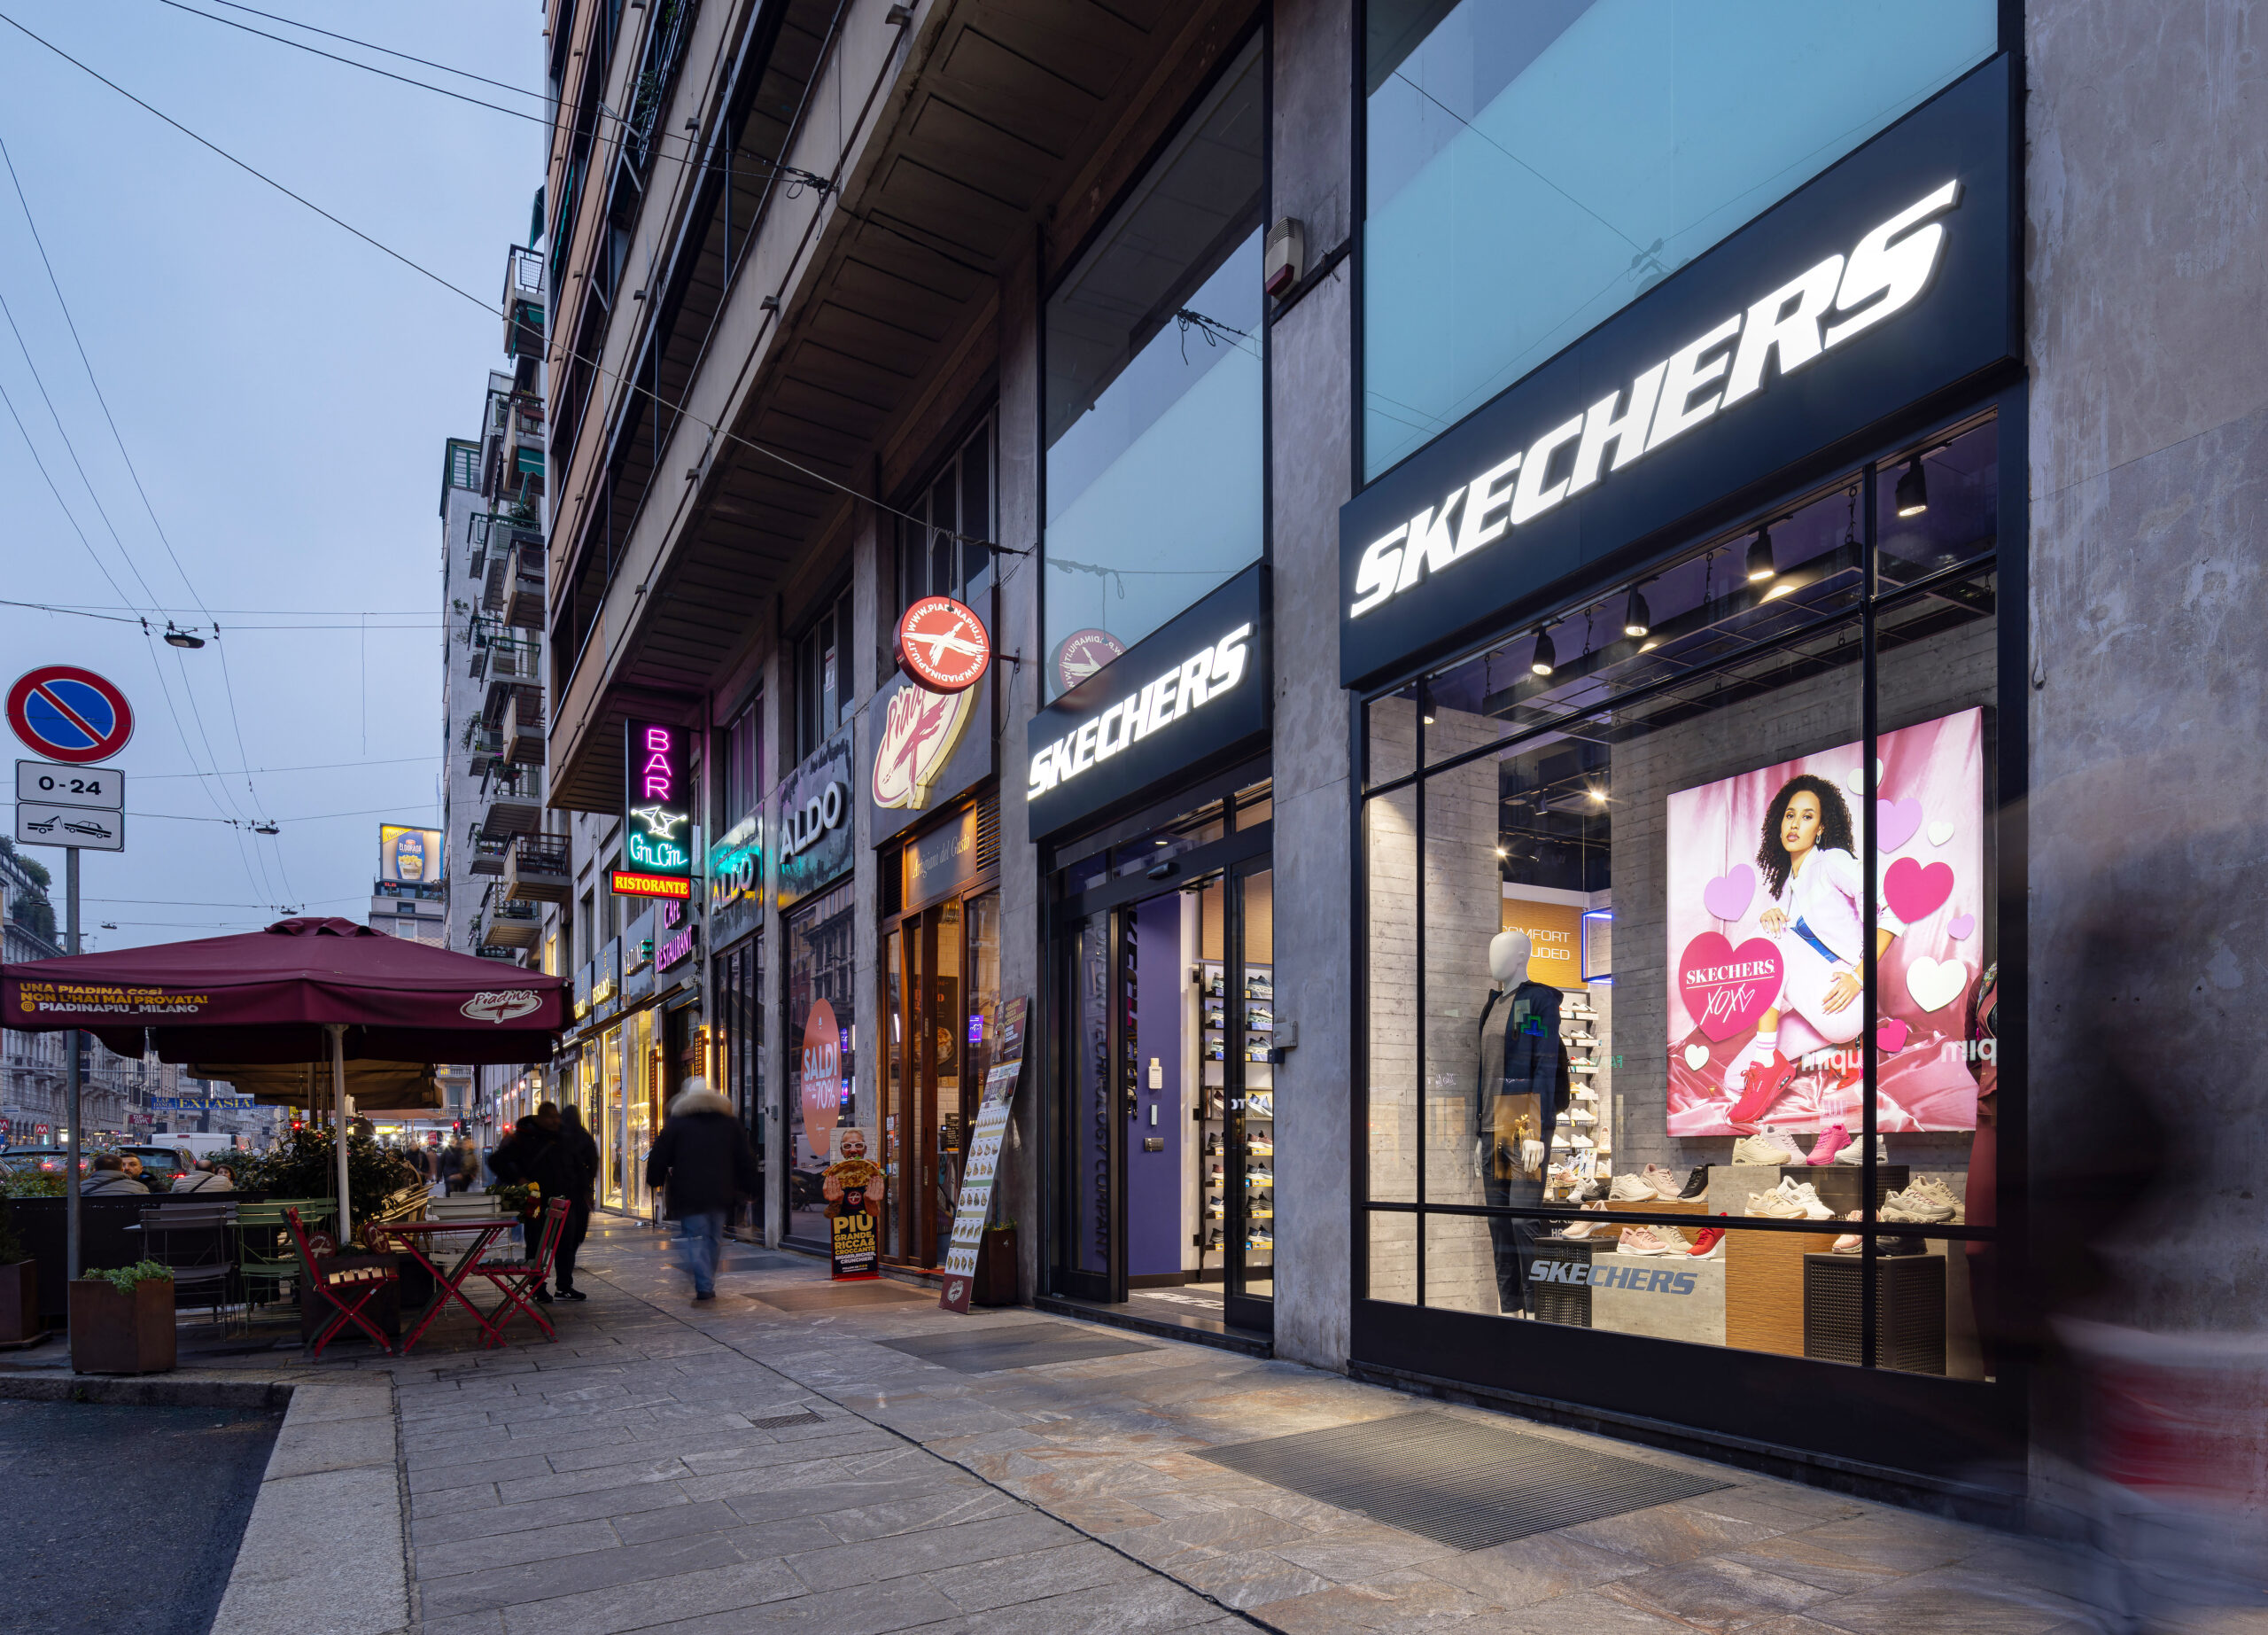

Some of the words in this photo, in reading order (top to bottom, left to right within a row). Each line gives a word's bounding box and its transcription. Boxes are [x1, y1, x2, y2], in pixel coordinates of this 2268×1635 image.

[1350, 179, 1961, 619] SKECHERS
[907, 603, 983, 645] WWW.PIADNAPIU.IT
[887, 683, 927, 751] Piad
[1028, 622, 1250, 801] SKECHERS
[643, 728, 672, 800] BAR
[780, 781, 842, 865] ALDO
[913, 845, 939, 879] Artigiani
[940, 840, 950, 863] del
[951, 834, 970, 857] Gusto
[615, 876, 688, 895] RISTORANTE
[711, 853, 754, 916] ALDO
[656, 925, 692, 973] RESTAURANT
[1503, 926, 1572, 943] MFORT
[624, 939, 645, 976] NADINE
[1530, 946, 1570, 961] UDED
[1686, 959, 1775, 985] SKECHERS
[19, 982, 55, 993] UNA
[58, 985, 124, 995] PIADINA
[20, 993, 57, 1002] NON
[58, 993, 99, 1003] L'HAI
[103, 994, 132, 1004] MAI
[134, 995, 208, 1004] PROVATA!
[475, 990, 531, 1005] Piadina
[39, 1002, 199, 1015] PIADINAPIU_MILANO
[804, 1041, 837, 1081] SALDI
[834, 1210, 874, 1234] PIÙ
[834, 1231, 874, 1242] GRANDE,
[835, 1245, 876, 1256] CROCCANTE
[1528, 1259, 1698, 1296] SKECHERS
